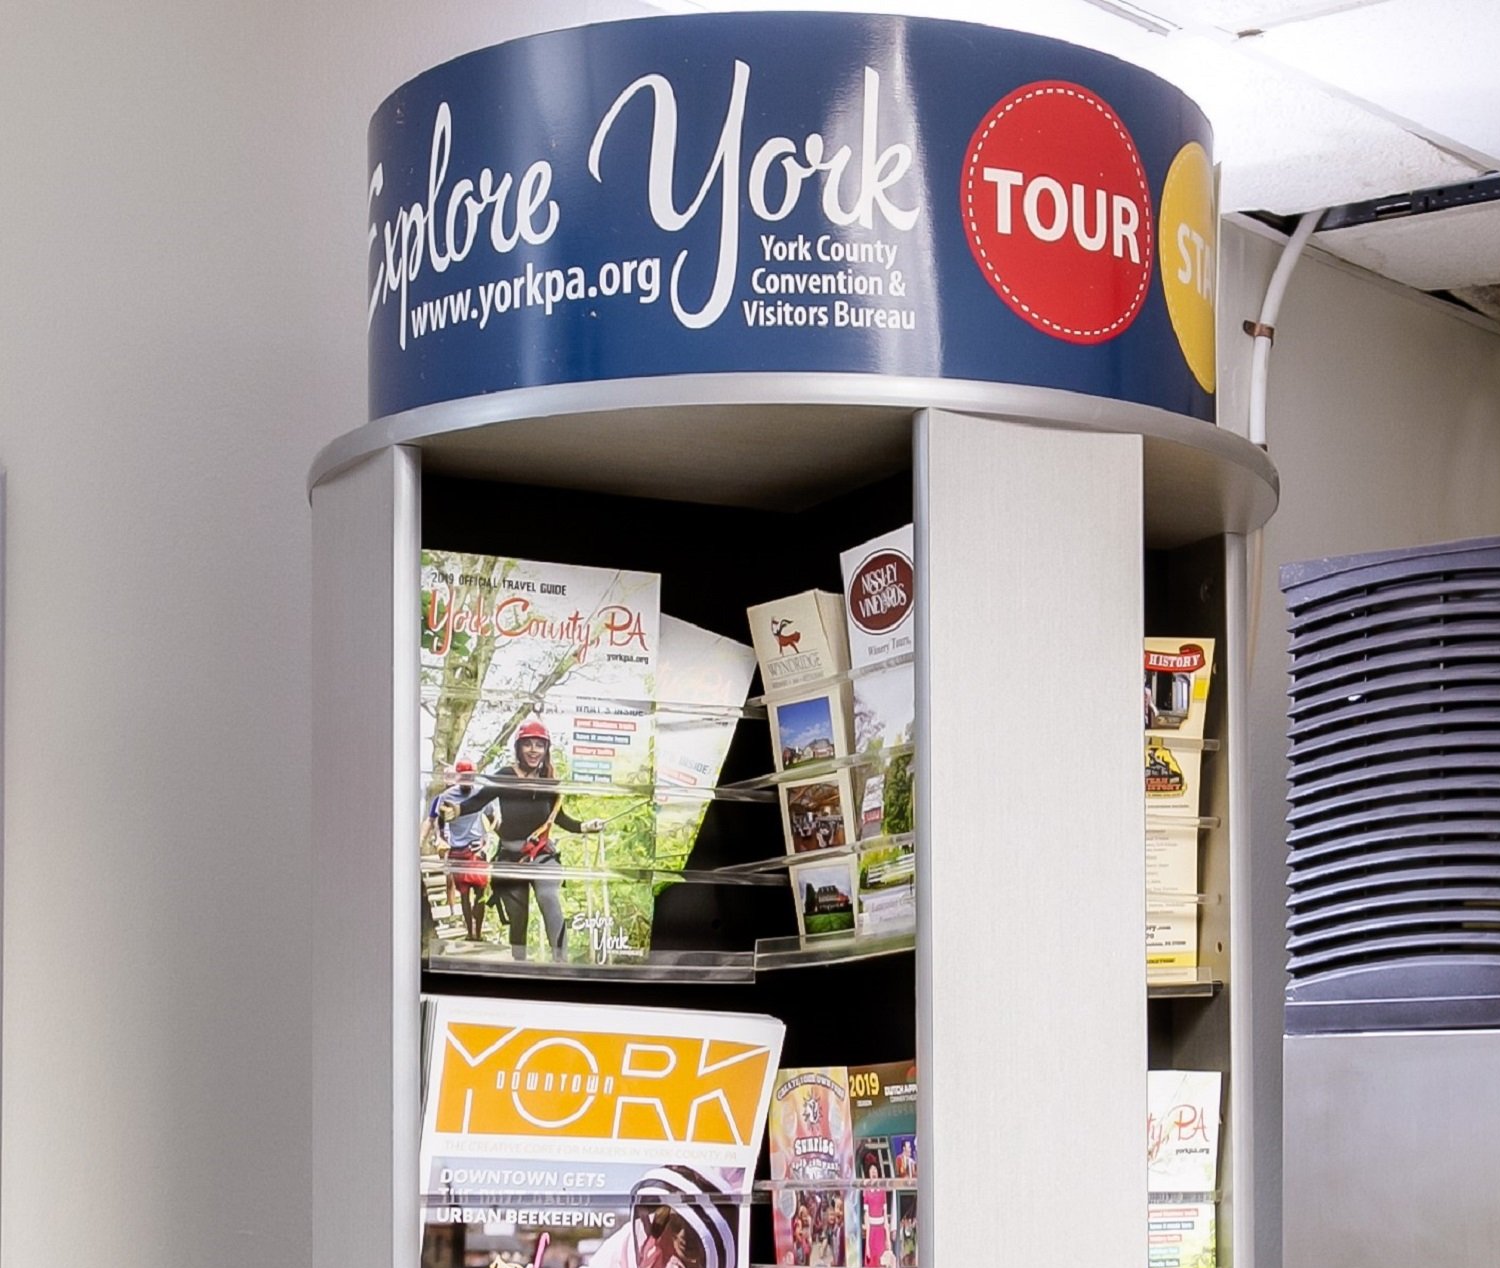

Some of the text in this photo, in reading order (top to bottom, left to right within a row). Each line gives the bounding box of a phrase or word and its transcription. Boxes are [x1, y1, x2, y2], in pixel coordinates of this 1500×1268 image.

[367, 59, 921, 351] Explore York
[983, 166, 1141, 264] TOUR
[760, 234, 898, 270] York County
[410, 256, 661, 339] www.yorkpa.org
[751, 267, 907, 298] Convention &
[743, 301, 916, 330] Visitors Bureau
[458, 573, 498, 591] OFFICIAL
[502, 579, 537, 593] TRAVEL
[540, 583, 568, 597] GUIDE
[861, 562, 898, 595] NISSLEY
[859, 583, 908, 618] VINEYARDS
[427, 586, 492, 656] York
[597, 604, 650, 651] PA
[606, 653, 649, 665] yorkpa.org
[1148, 653, 1201, 668] HISTORY
[593, 926, 632, 966] York
[445, 1025, 772, 1146] YORK
[496, 1070, 615, 1095] DOWNTOWN
[850, 1072, 880, 1097] 2019
[1167, 1103, 1210, 1143] PA
[440, 1168, 606, 1188] DOWNTOWN GETS
[436, 1206, 616, 1228] URBAN BEEKEEPING
